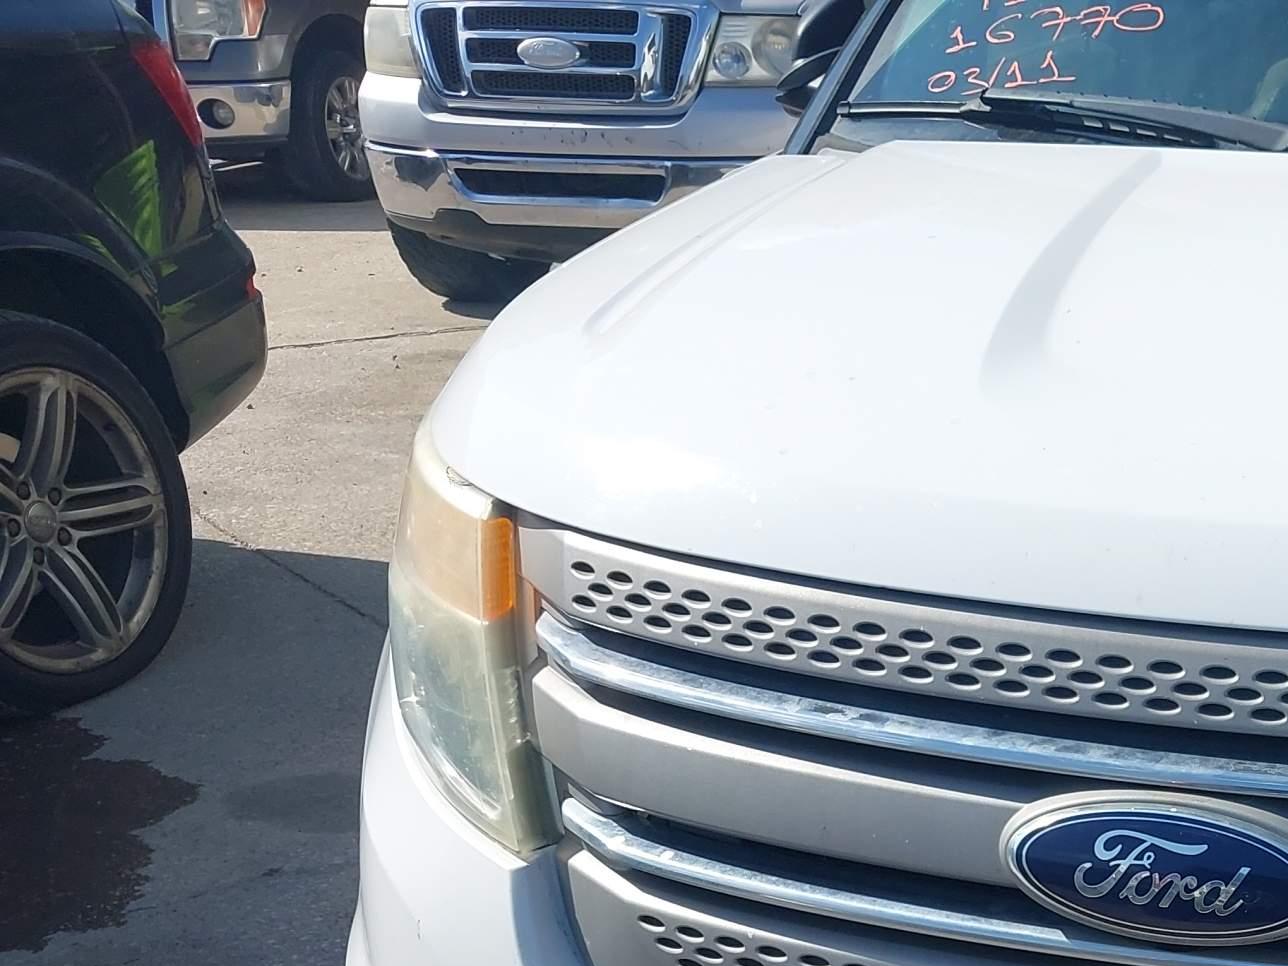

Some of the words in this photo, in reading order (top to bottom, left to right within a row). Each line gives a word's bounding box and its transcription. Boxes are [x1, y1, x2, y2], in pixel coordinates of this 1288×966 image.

[945, 4, 1164, 53] 16770
[927, 50, 1077, 95] 03/11
[1074, 829, 1252, 917] Ford
